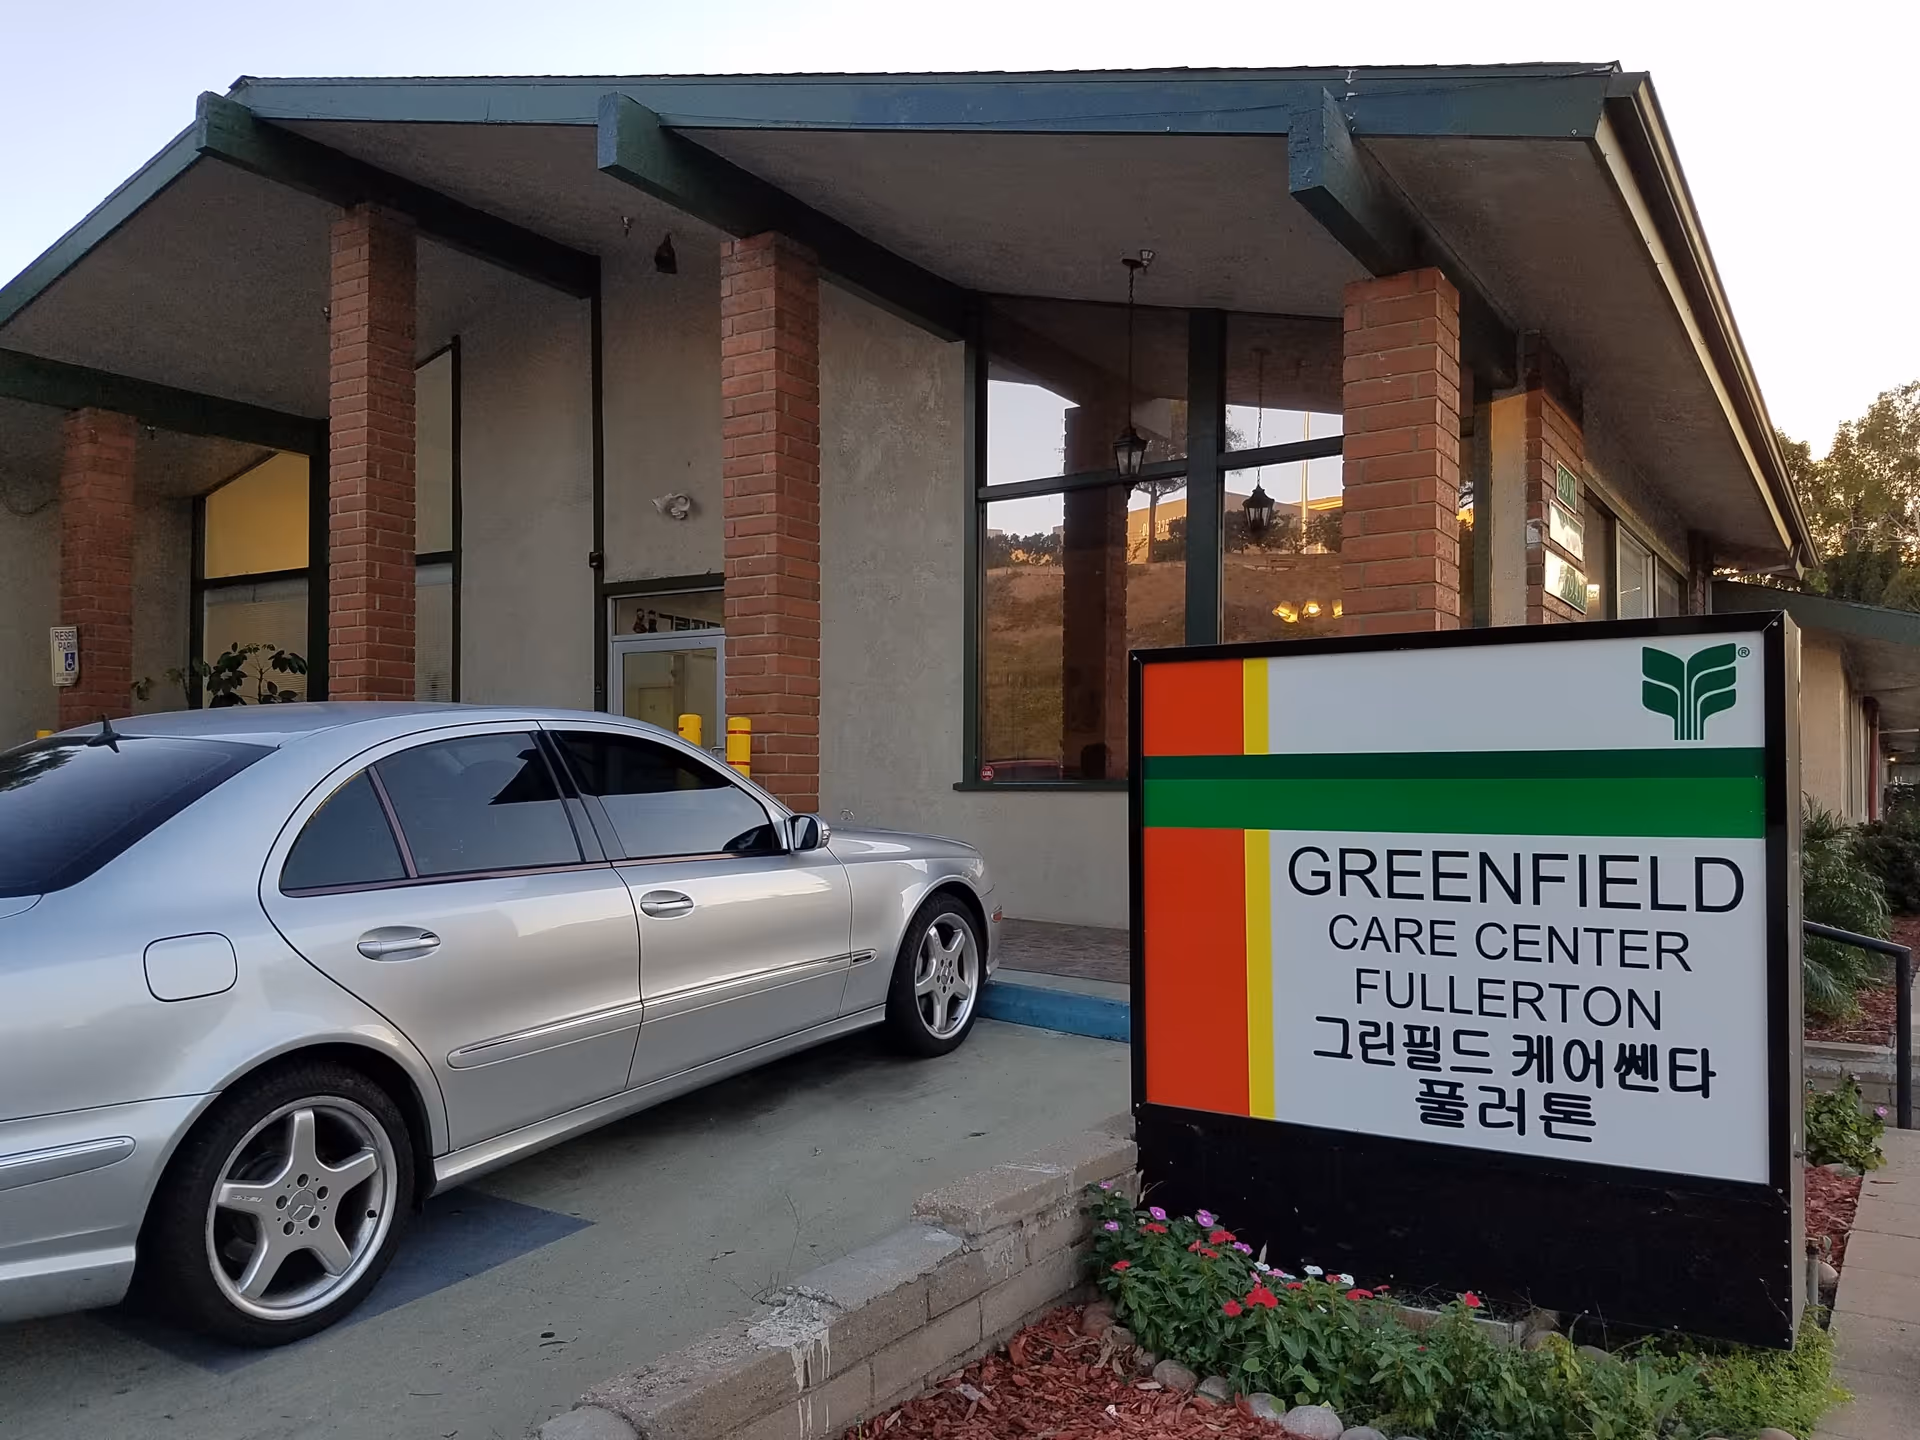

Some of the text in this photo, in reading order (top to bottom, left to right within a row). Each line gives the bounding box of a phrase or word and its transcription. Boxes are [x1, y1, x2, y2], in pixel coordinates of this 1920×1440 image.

[1288, 846, 1745, 913] GREENFIELD
[1328, 914, 1693, 972] CARE CENTER
[1356, 967, 1661, 1031] FULLERTON
[1313, 1015, 1717, 1099] 그린필드 케어쎈타
[1414, 1078, 1597, 1143] 풀러톤
